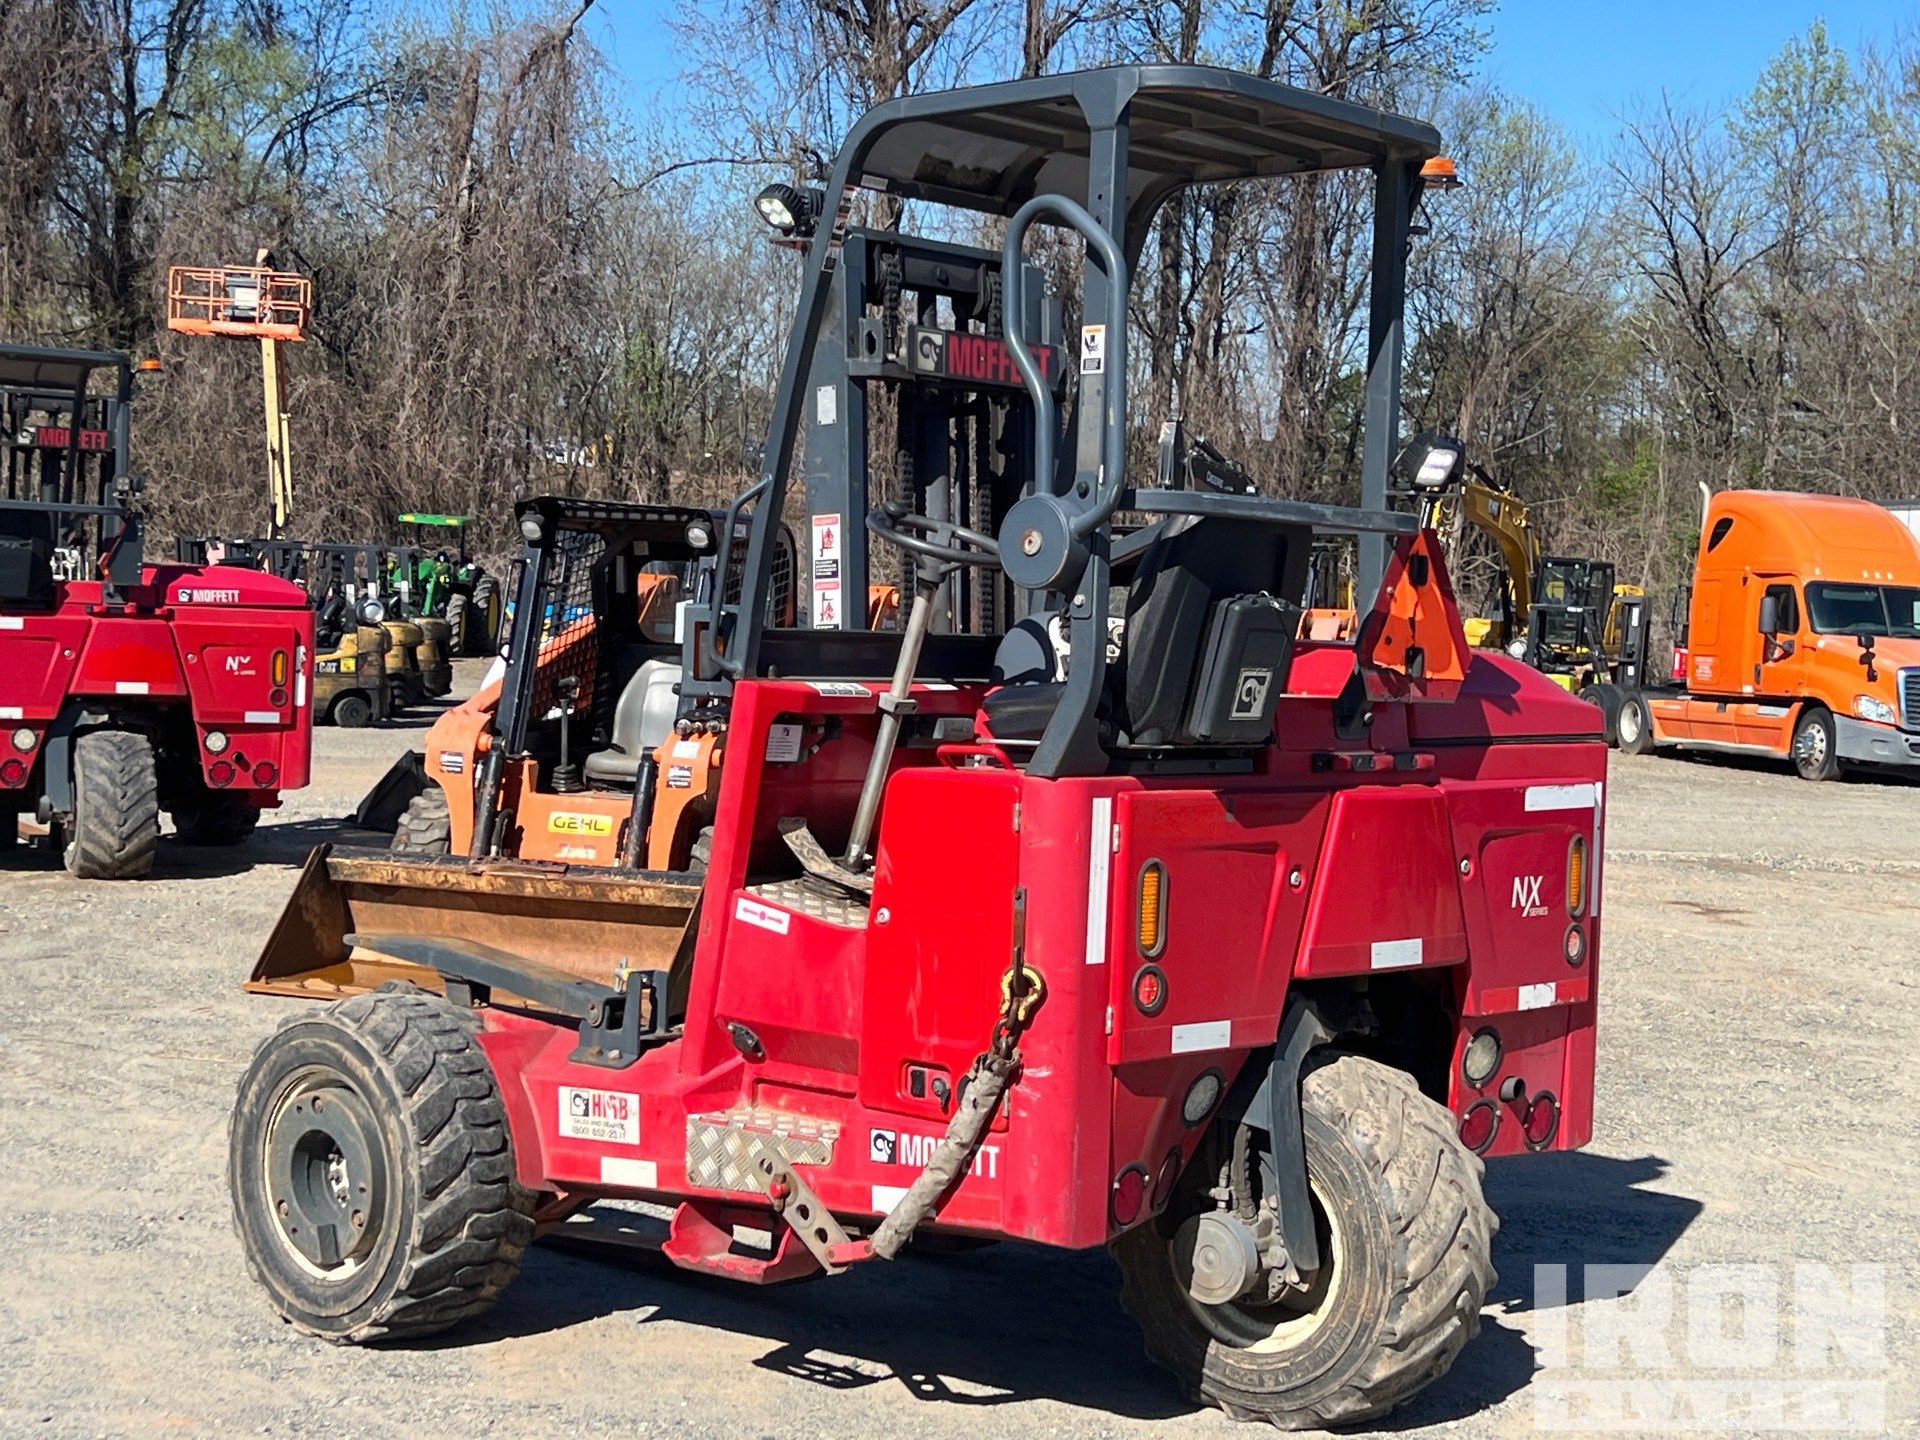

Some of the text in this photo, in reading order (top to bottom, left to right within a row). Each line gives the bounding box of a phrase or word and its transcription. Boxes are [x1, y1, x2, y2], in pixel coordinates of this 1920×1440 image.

[948, 336, 1050, 384] MOFFT
[38, 426, 109, 450] MOETT
[192, 589, 240, 603] MOFFETT
[553, 815, 606, 832] GEHL
[1511, 875, 1544, 918] NX
[900, 1133, 1000, 1178] MOTT
